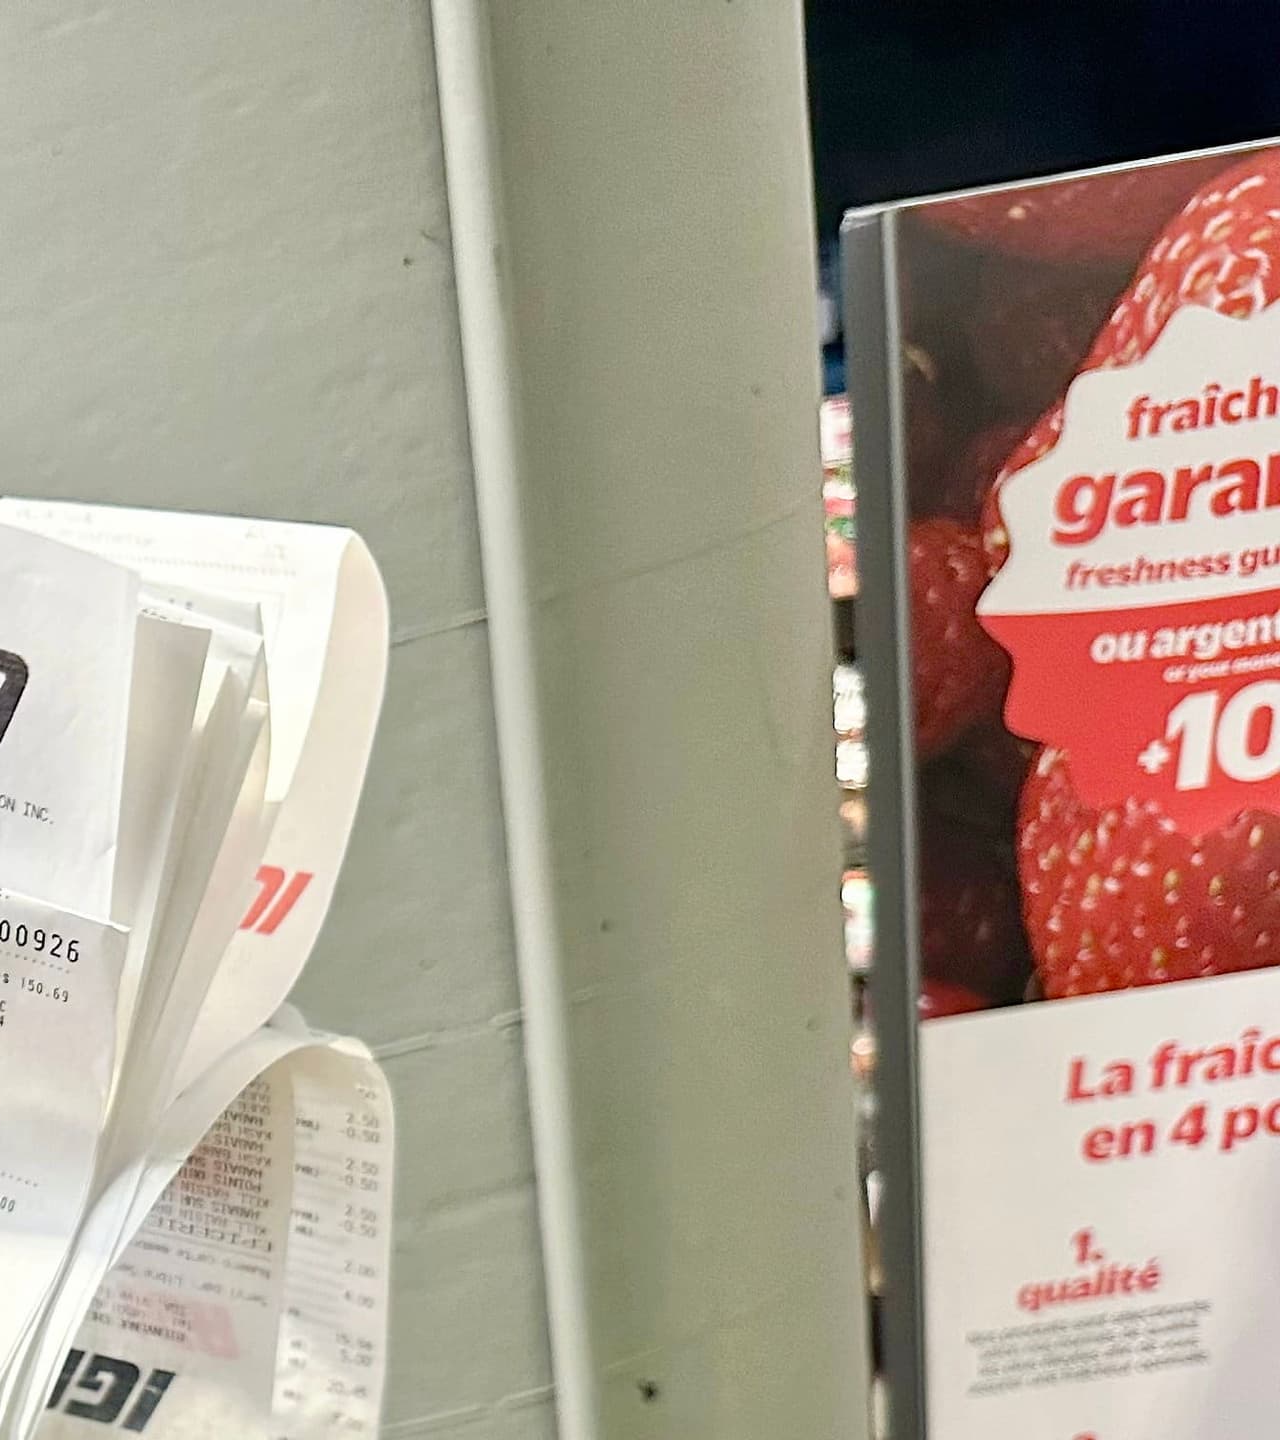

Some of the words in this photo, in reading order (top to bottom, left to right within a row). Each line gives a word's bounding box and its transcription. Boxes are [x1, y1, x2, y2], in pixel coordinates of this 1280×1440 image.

[1050, 453, 1280, 547] gara
[1066, 552, 1230, 591] freshness
[1091, 631, 1148, 663] ou
[23, 803, 54, 825] INC.
[21, 977, 69, 1003] 150.69
[1066, 1057, 1134, 1101] La
[1082, 1119, 1156, 1163] en
[1169, 1102, 1207, 1147] 4
[1070, 1226, 1104, 1263] 1.
[1017, 1257, 1161, 1311] qualité
